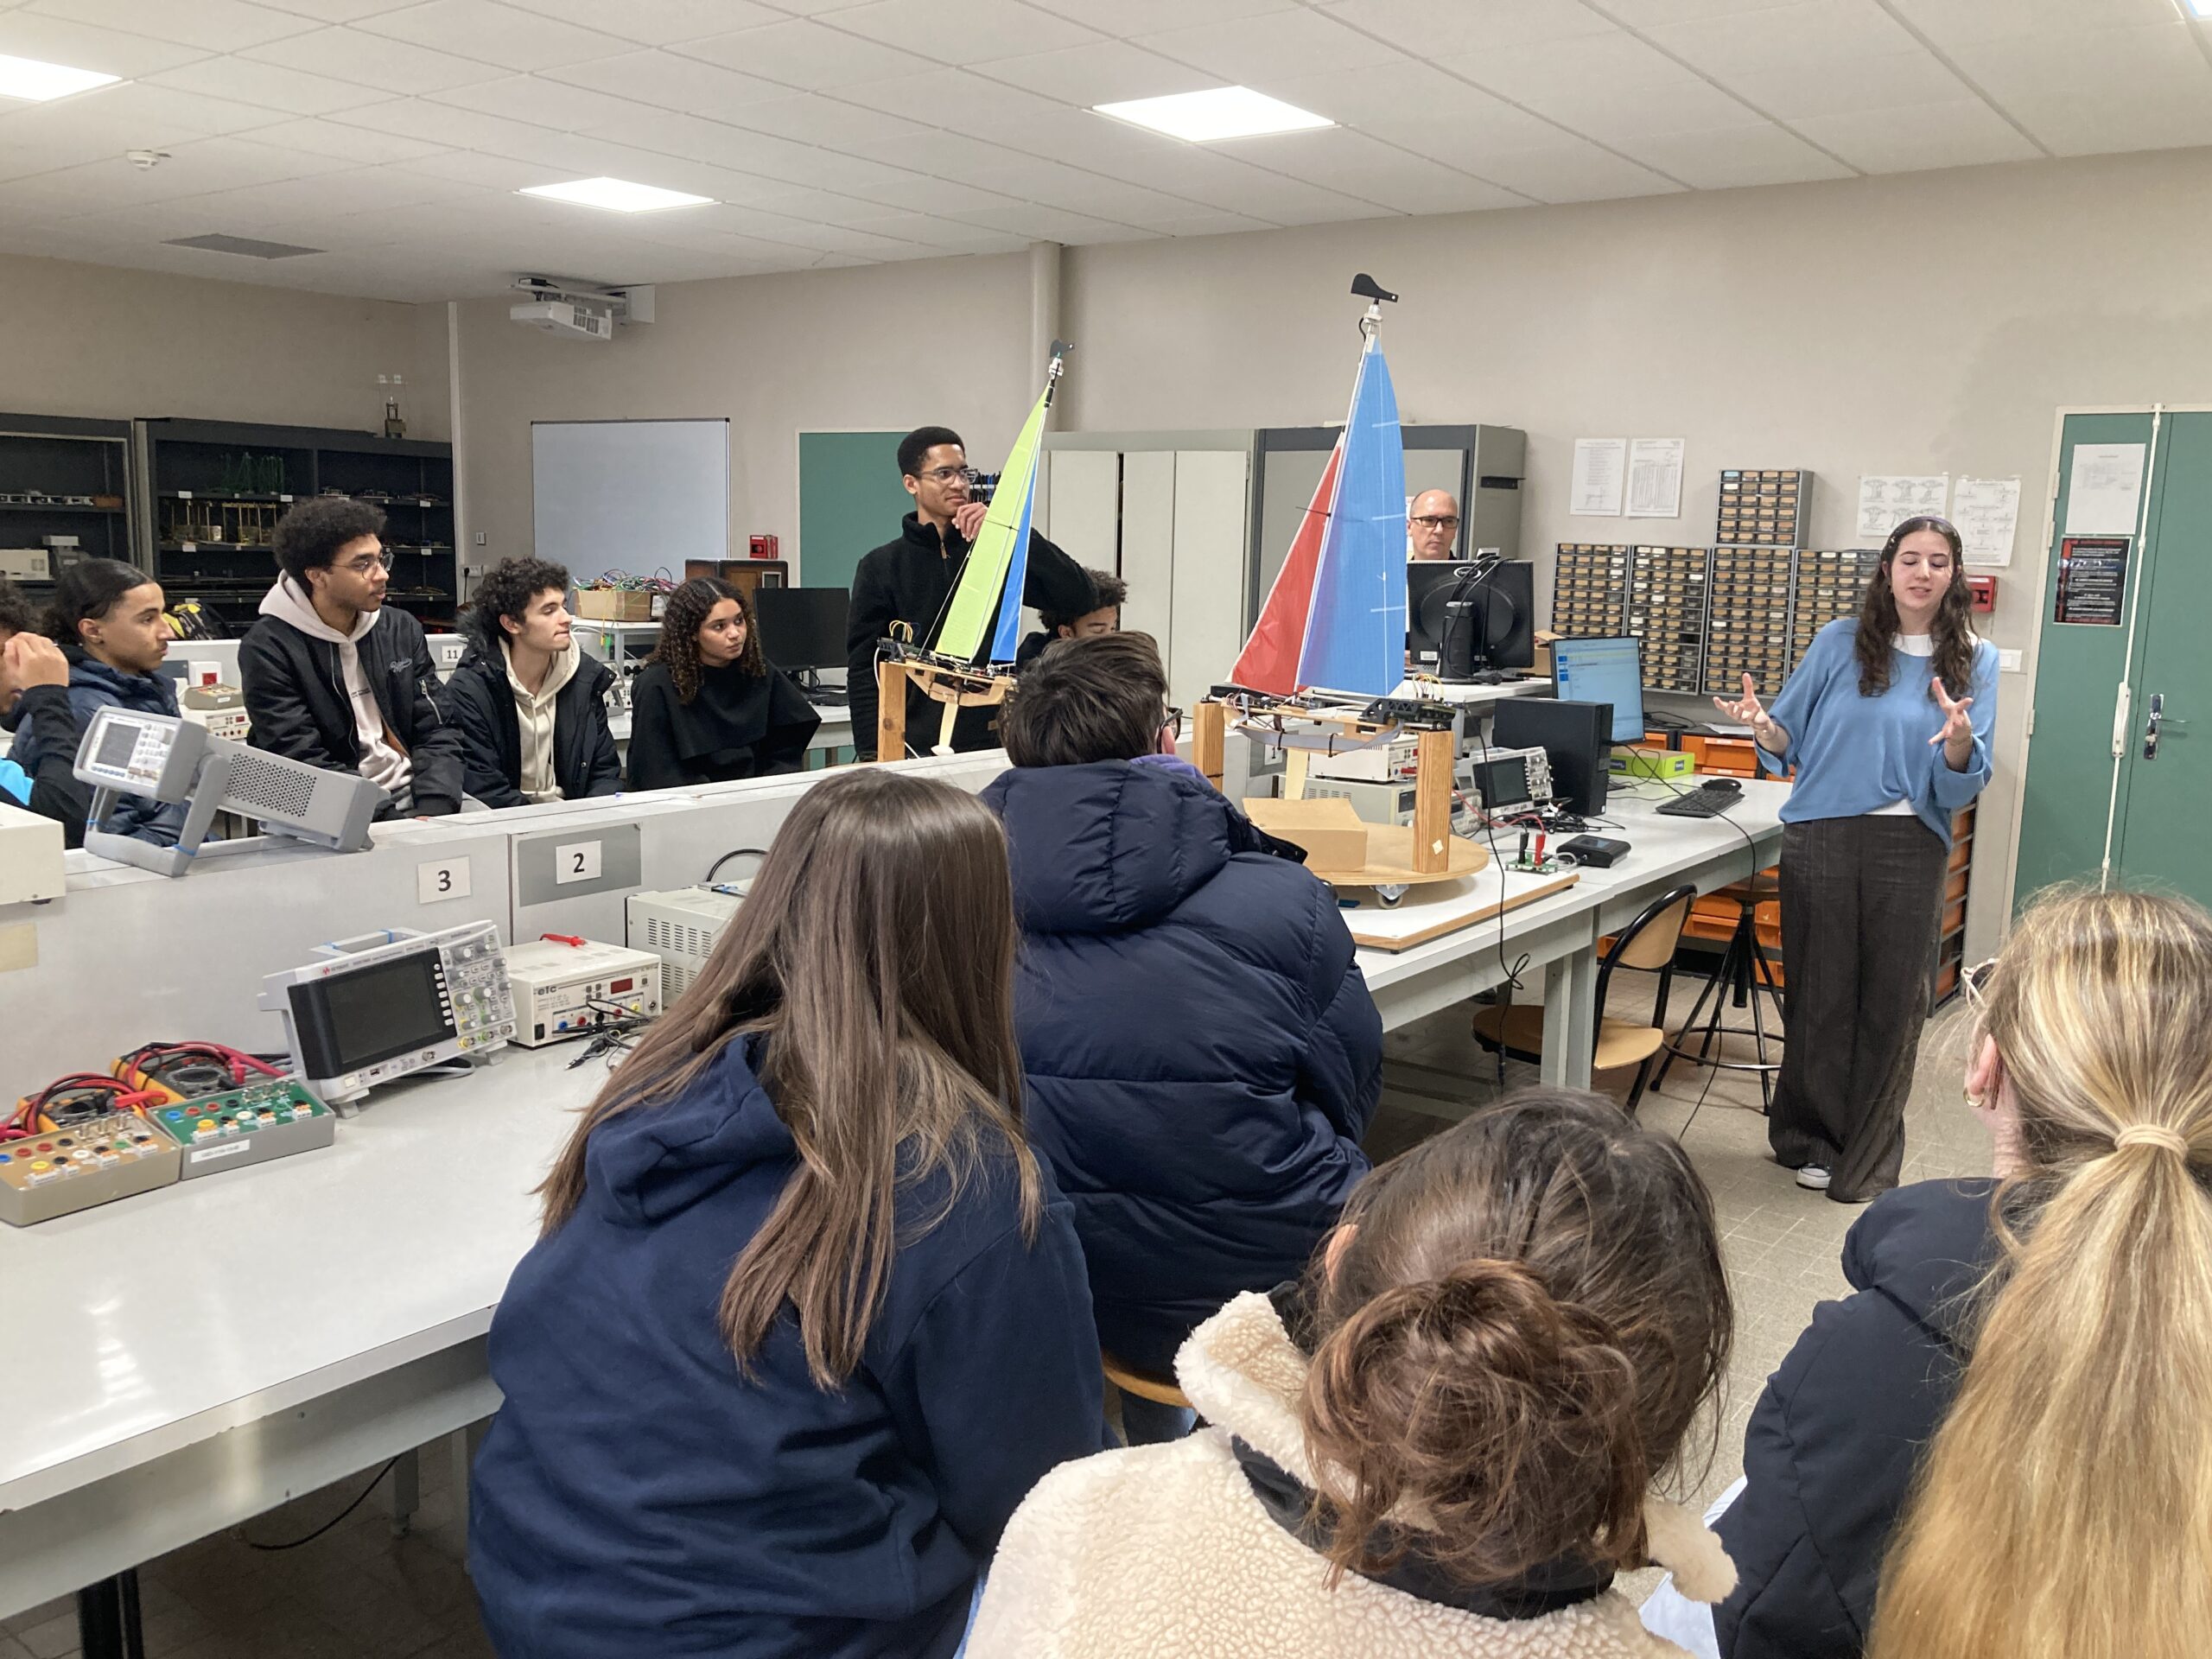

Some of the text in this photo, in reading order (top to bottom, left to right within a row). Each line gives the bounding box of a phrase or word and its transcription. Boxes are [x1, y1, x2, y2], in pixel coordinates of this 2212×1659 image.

[447, 650, 458, 659] 11
[573, 852, 585, 874] 2
[437, 869, 452, 892] 3
